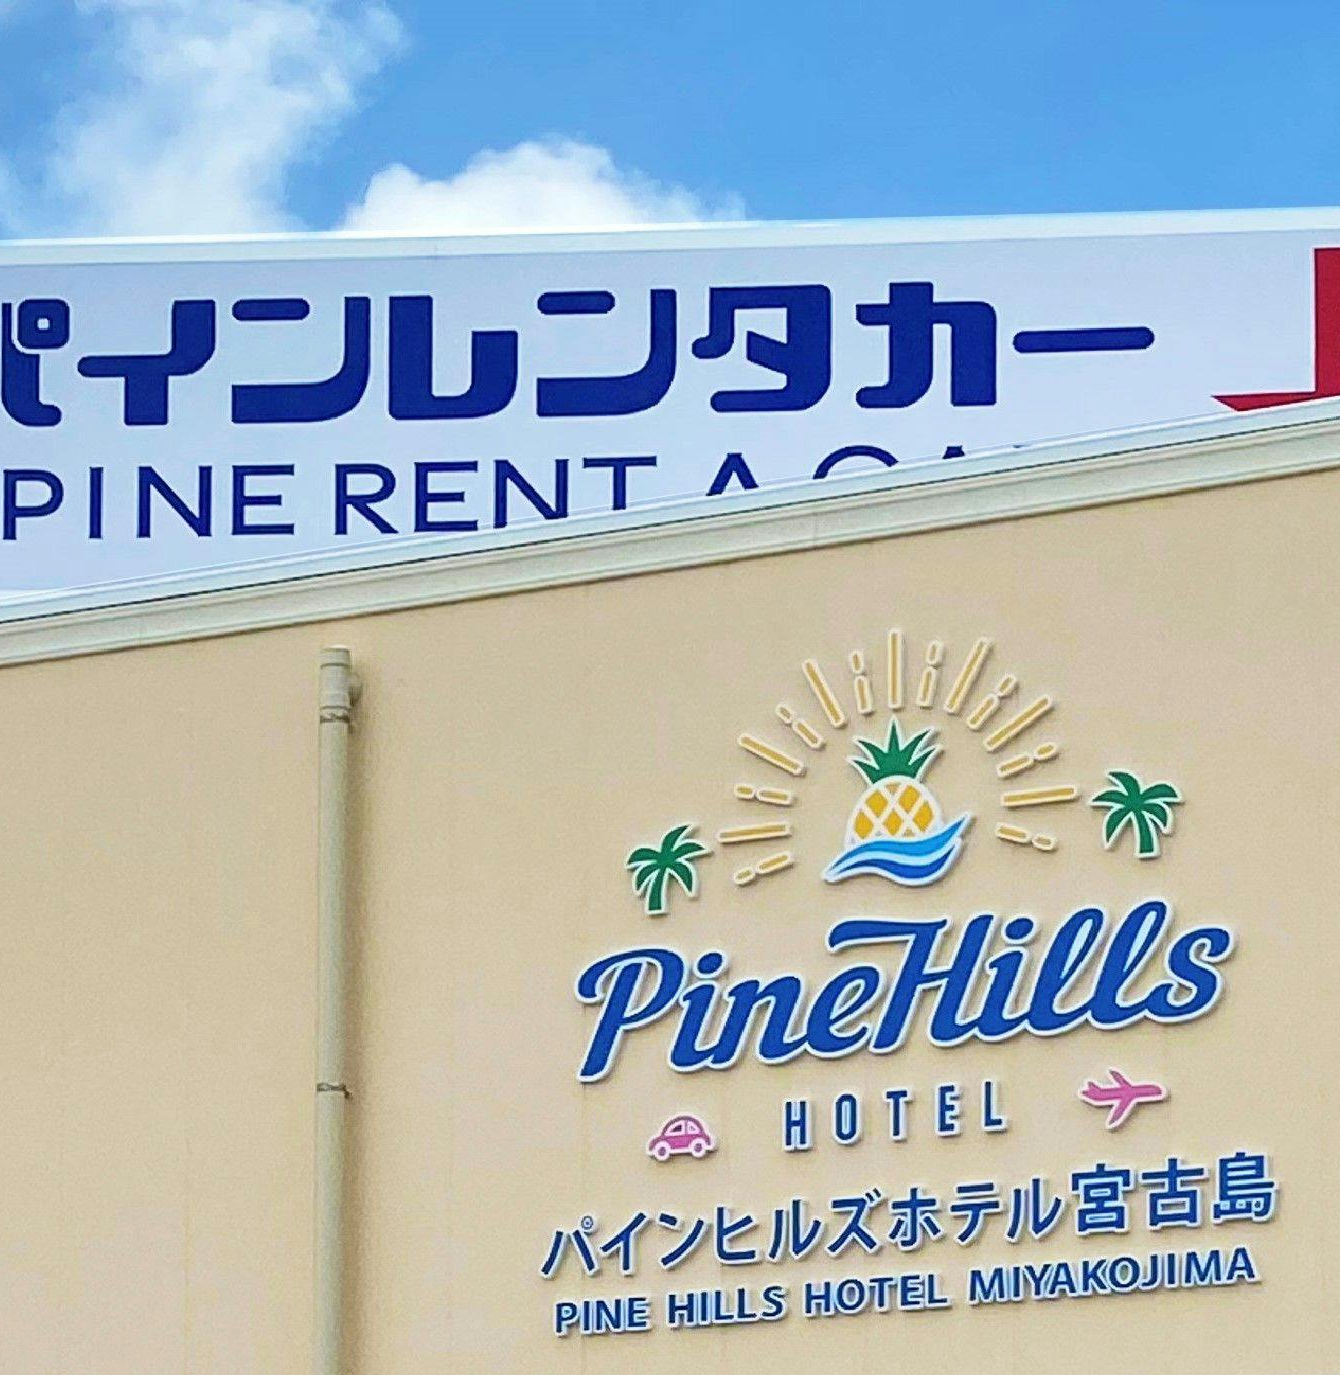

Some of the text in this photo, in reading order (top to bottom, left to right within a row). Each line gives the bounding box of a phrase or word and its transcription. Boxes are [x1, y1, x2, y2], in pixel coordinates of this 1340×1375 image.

[2, 463, 295, 541] PINE
[334, 456, 657, 536] RENT
[783, 1082, 1004, 1148] HOTEL
[542, 1152, 1276, 1275] パインヒルズホテル宮古島
[555, 1247, 1257, 1333] PINE HILLS HOTEL MIYAKOJIMA
